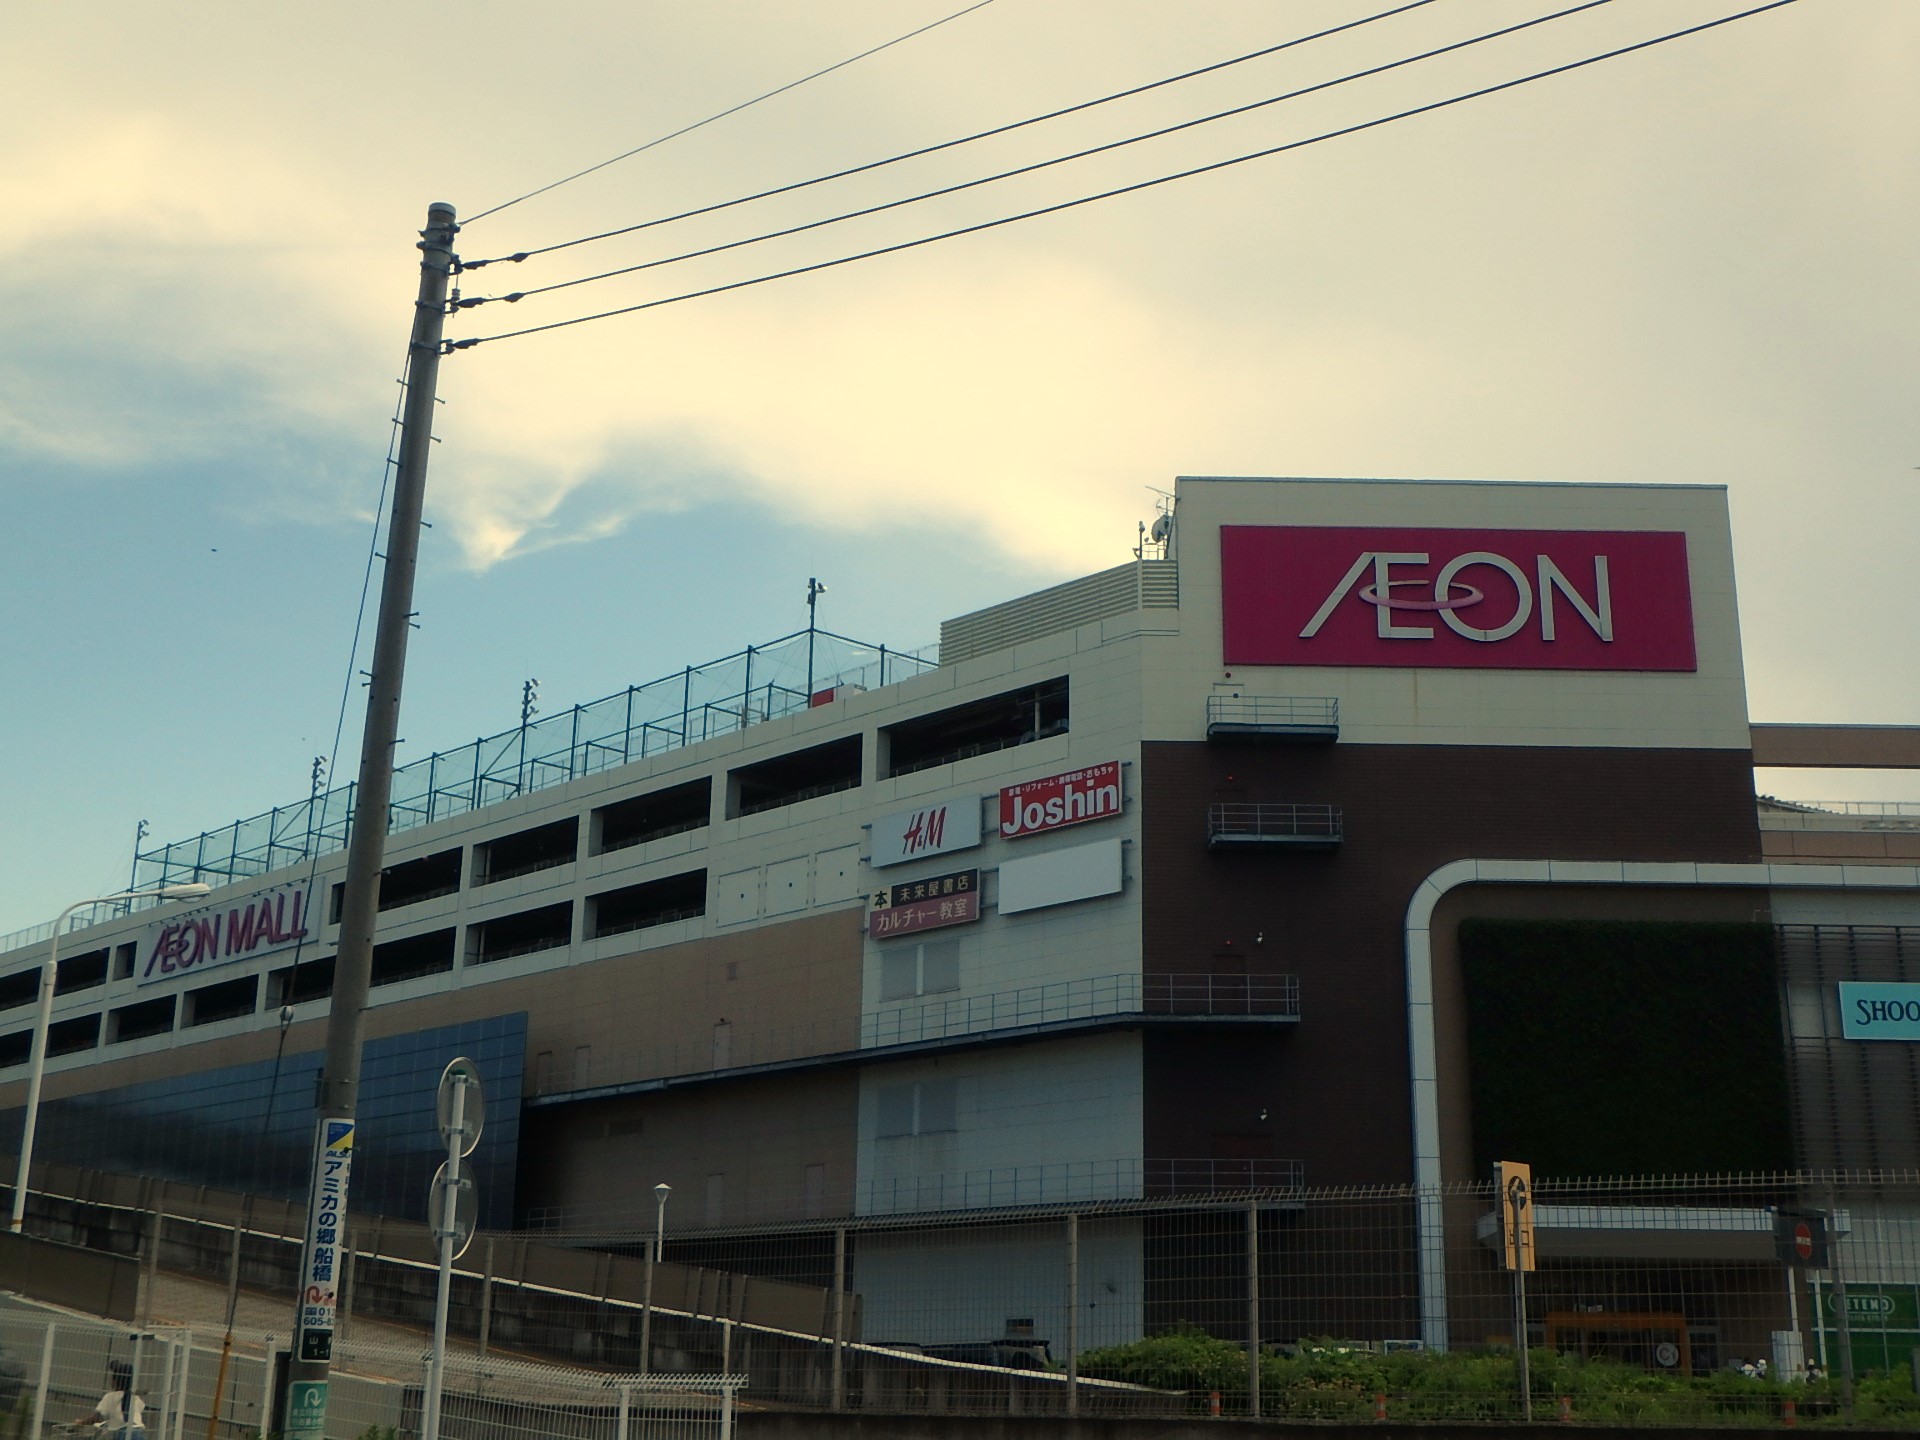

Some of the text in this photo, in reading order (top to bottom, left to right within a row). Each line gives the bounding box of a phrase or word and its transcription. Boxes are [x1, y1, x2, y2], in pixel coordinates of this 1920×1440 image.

[902, 806, 947, 854] H&M
[1002, 779, 1117, 834] Joshin
[874, 875, 969, 909] 本 未来屋書店
[877, 898, 967, 933] カルチャー教室
[225, 890, 309, 957] MALL
[312, 1161, 342, 1282] アミカの郷船橋
